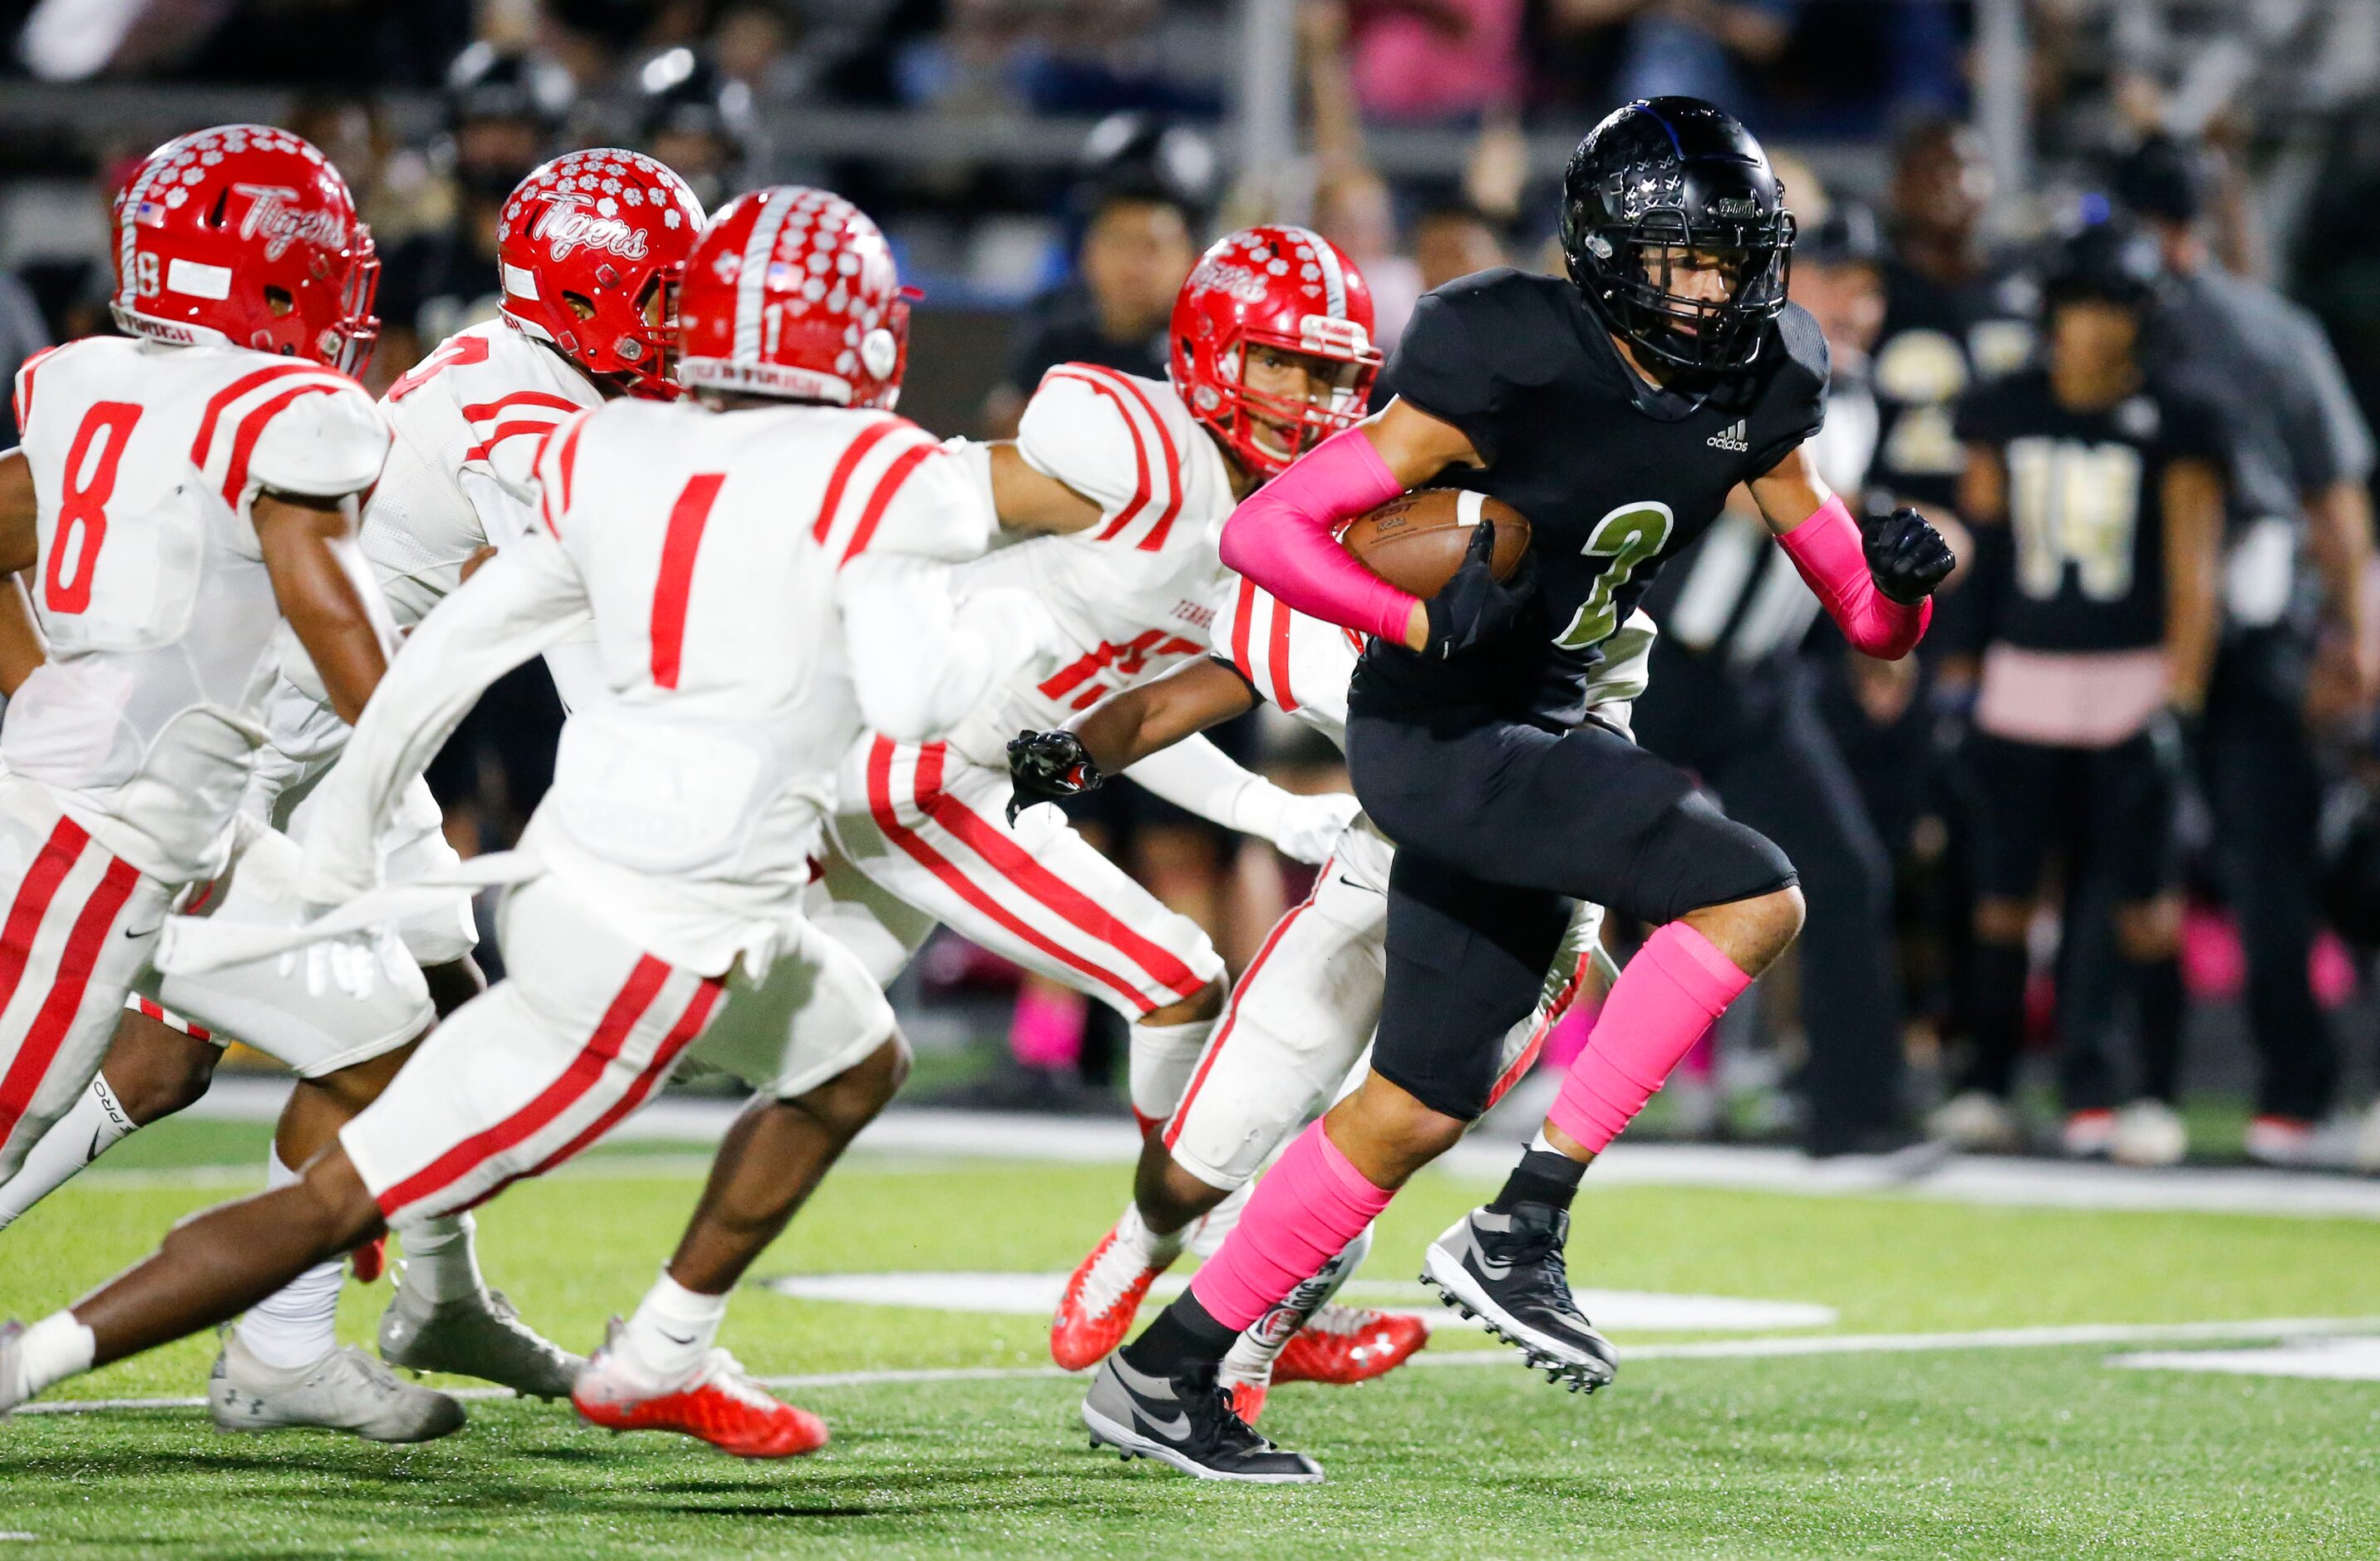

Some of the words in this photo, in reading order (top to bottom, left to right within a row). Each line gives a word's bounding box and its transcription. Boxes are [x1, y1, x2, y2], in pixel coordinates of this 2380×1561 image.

[232, 183, 347, 263] Tigers
[533, 190, 649, 262] Tigers
[136, 251, 160, 298] 8
[764, 318, 783, 354] 1
[1706, 436, 1748, 452] adidas
[45, 396, 144, 615] 8
[649, 472, 728, 691] 1
[1551, 500, 1674, 652] 2
[94, 1081, 125, 1124] PRO
